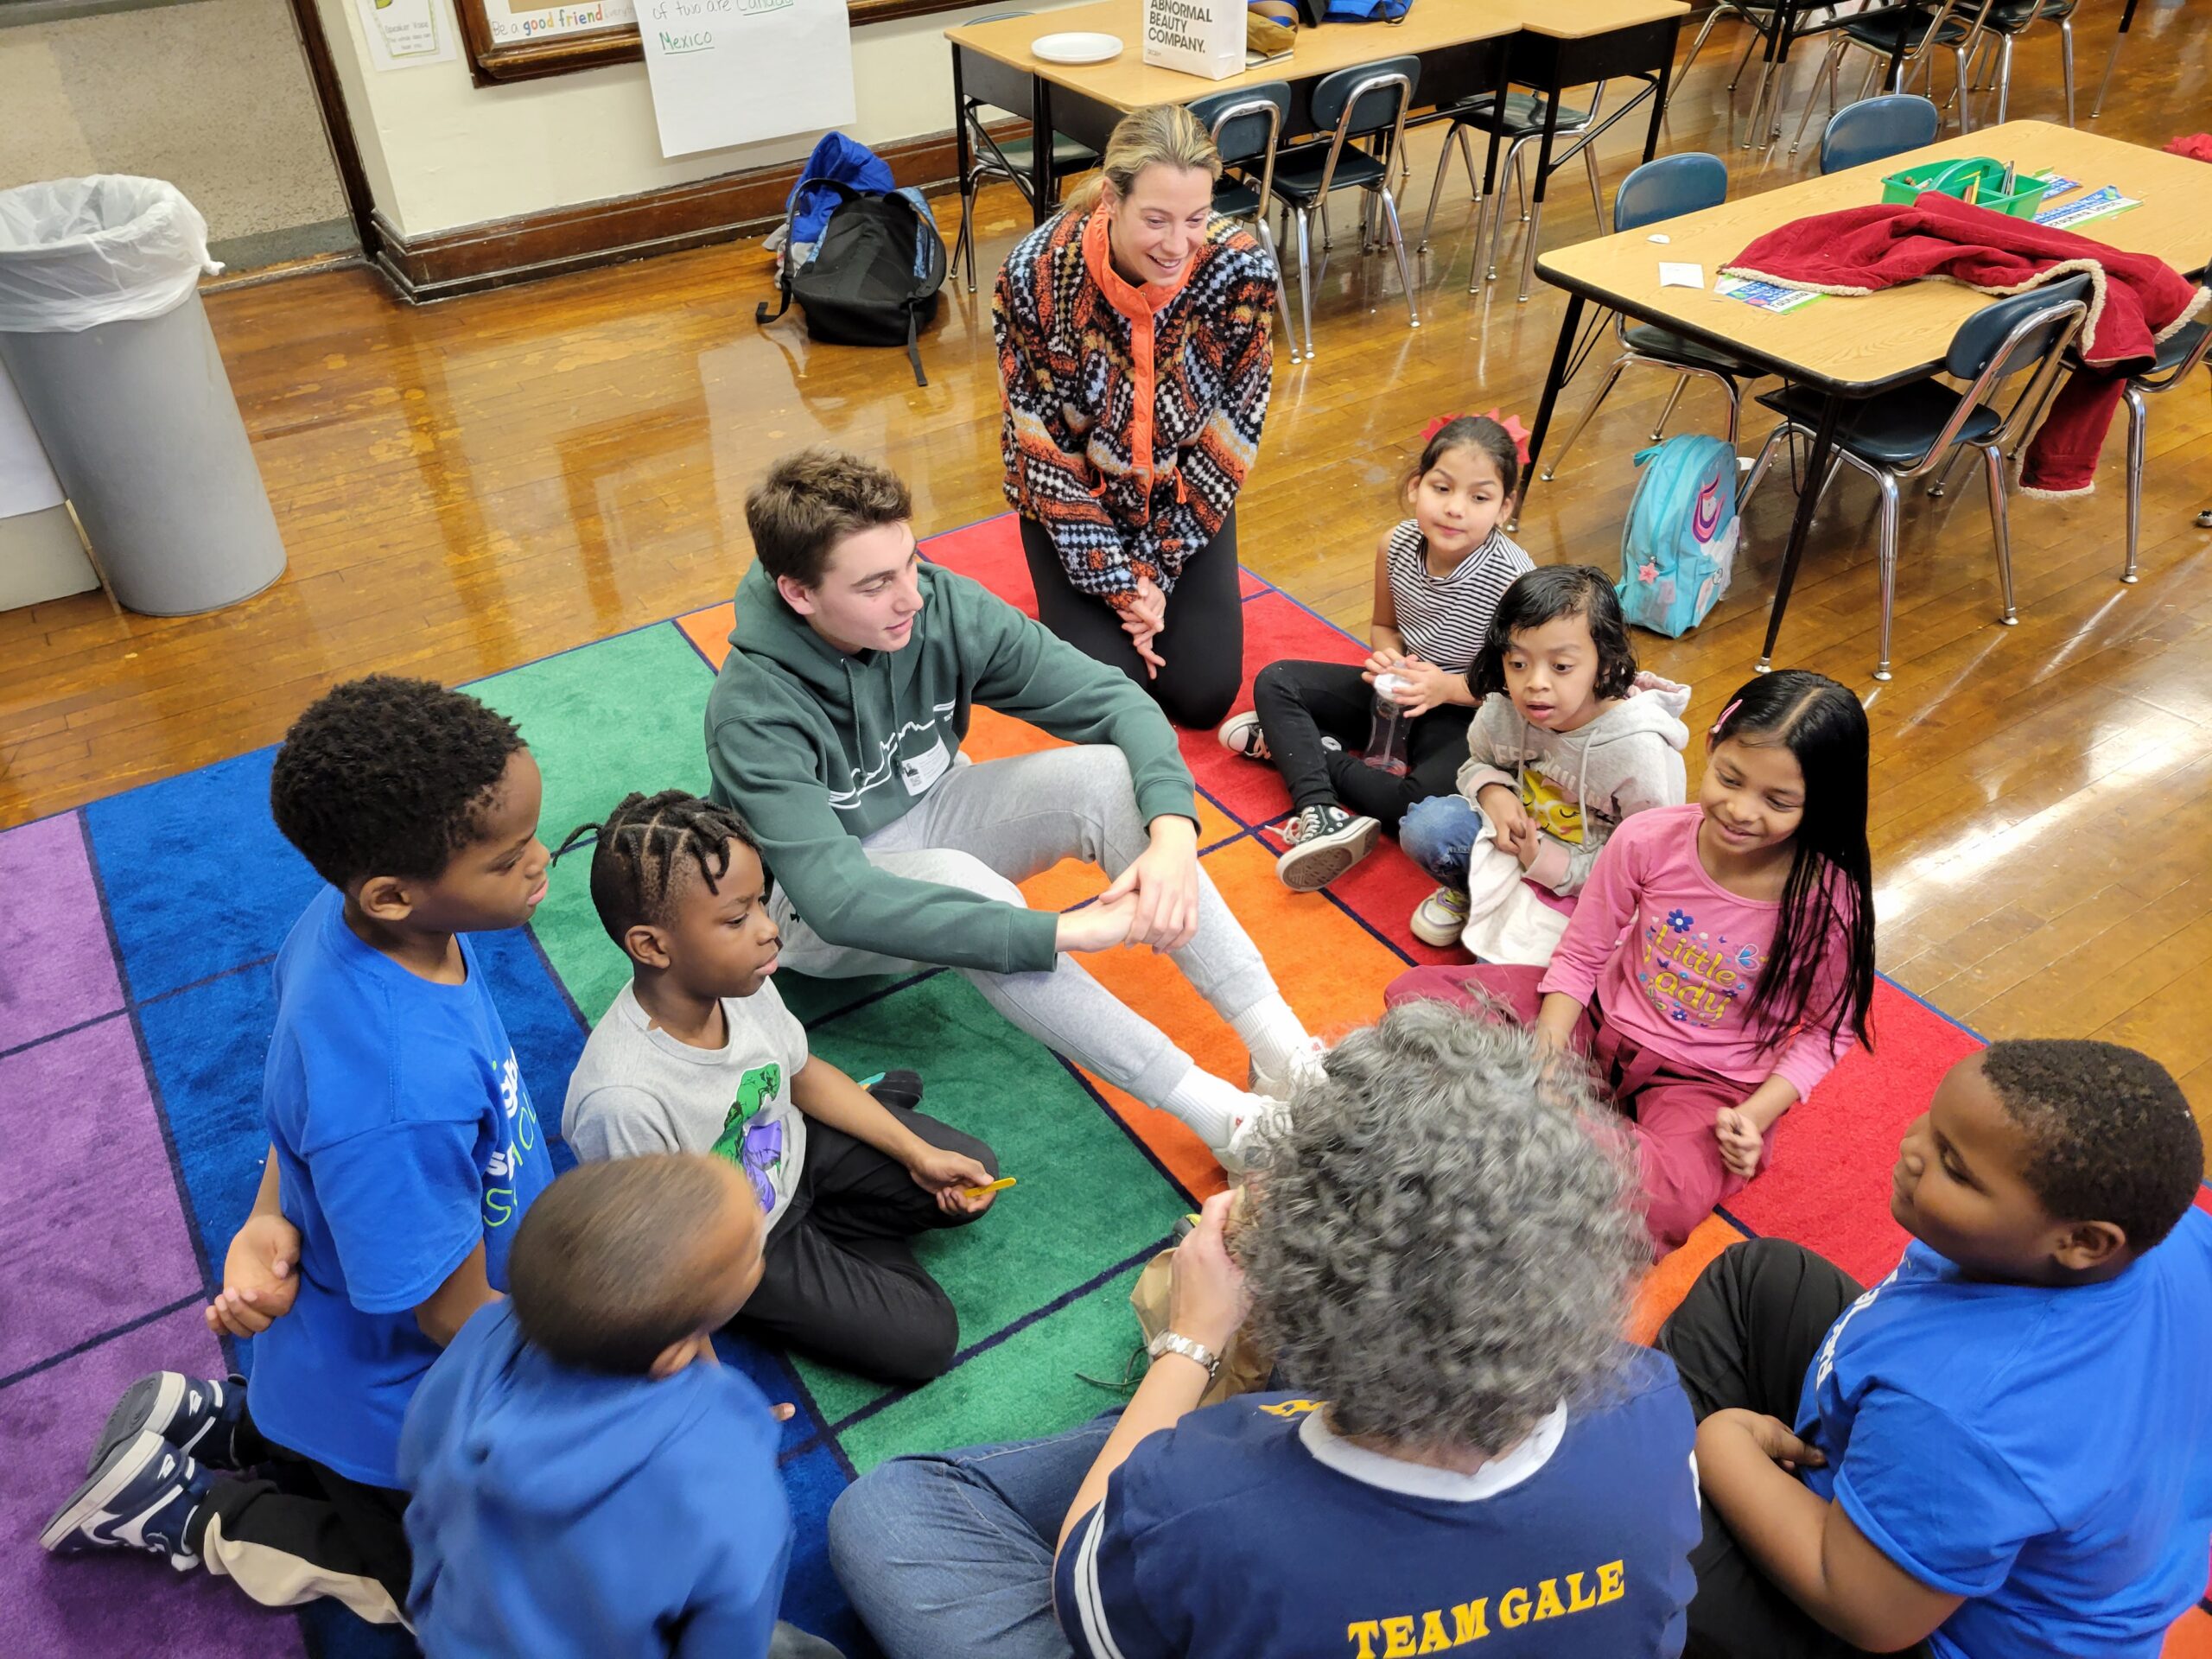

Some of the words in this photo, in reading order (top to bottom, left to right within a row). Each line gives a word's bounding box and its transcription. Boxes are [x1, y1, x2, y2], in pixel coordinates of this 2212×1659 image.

[523, 11, 555, 36] good
[559, 3, 603, 28] friend
[652, 2, 668, 20] of
[676, 4, 701, 16] two
[706, 0, 732, 12] are
[1149, 10, 1188, 34] BEAUTY
[1150, 0, 1213, 22] ABNORMAL
[658, 31, 713, 51] Mexico
[1147, 27, 1206, 54] COMPANY.
[1655, 924, 1737, 987] Little
[1347, 1597, 1491, 1659] TEAM
[1498, 1559, 1626, 1630] GALE
